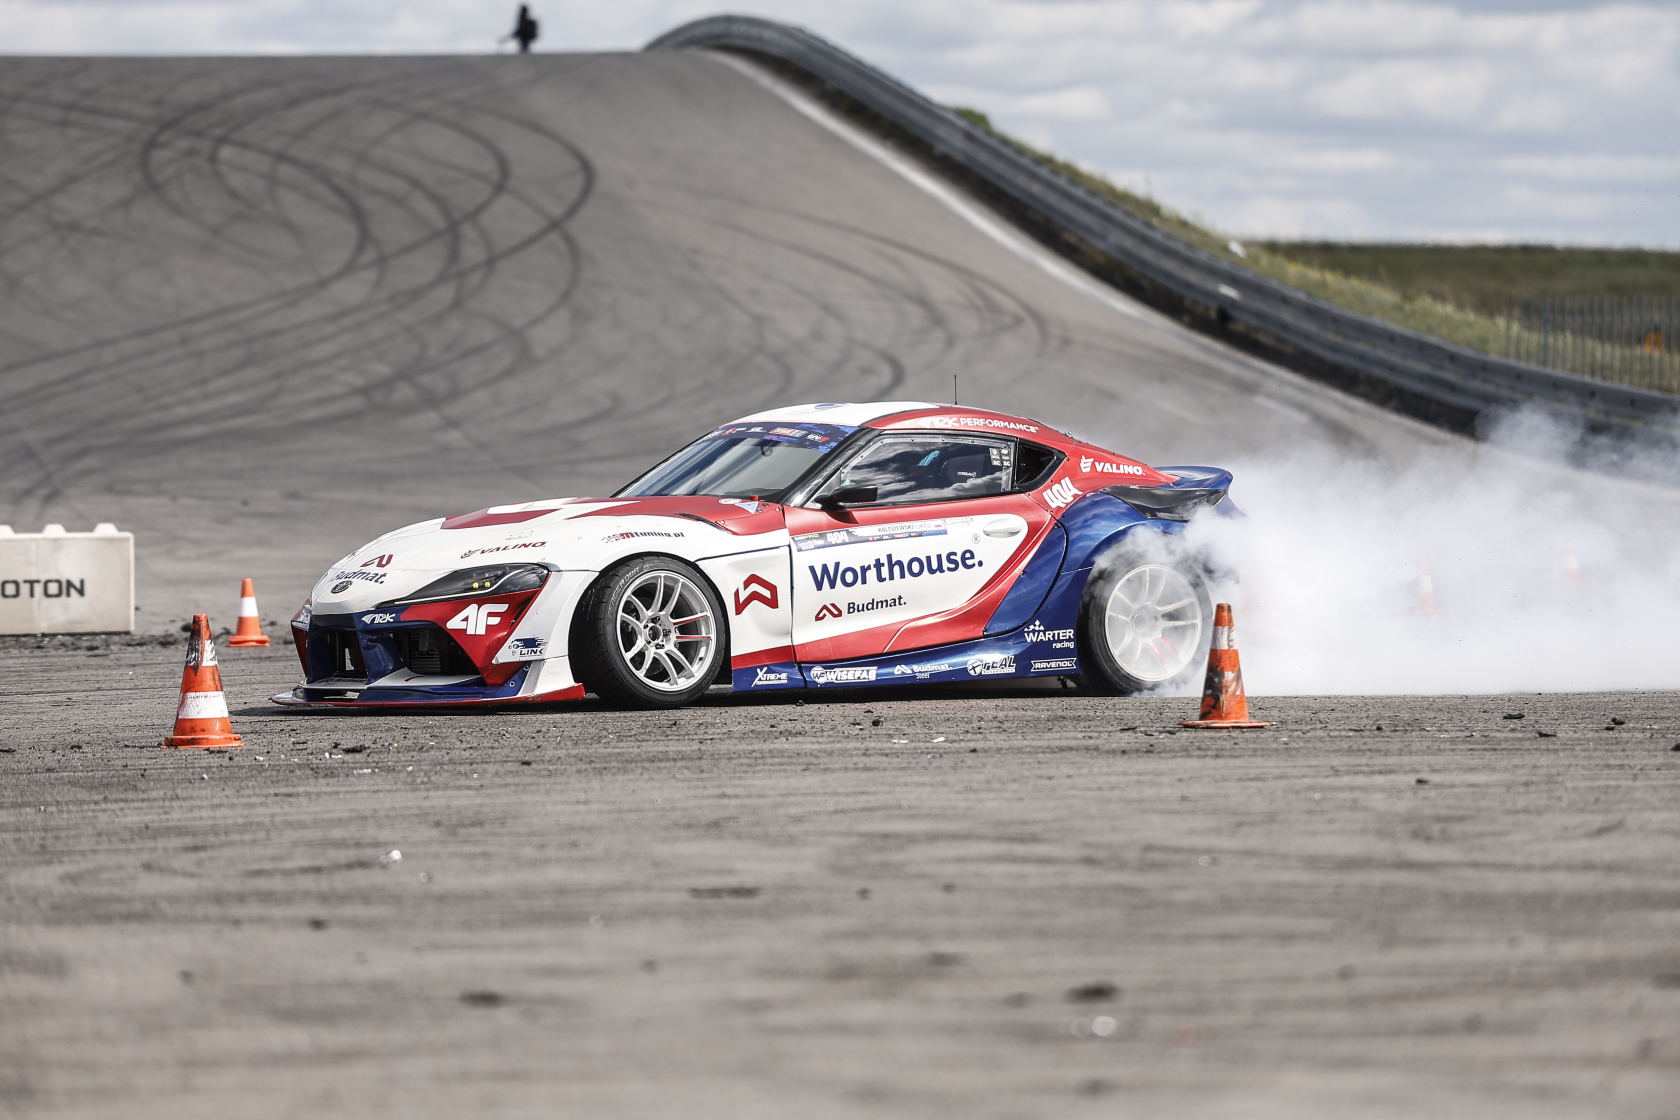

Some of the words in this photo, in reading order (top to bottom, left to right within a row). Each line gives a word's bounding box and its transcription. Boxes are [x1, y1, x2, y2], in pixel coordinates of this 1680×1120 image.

[960, 418, 1036, 433] PERFORMANCE
[1042, 476, 1083, 509] 404
[826, 531, 849, 545] 404
[1024, 629, 1074, 643] WARTER
[1052, 641, 1075, 649] racing
[1035, 660, 1073, 669] RAVENOL
